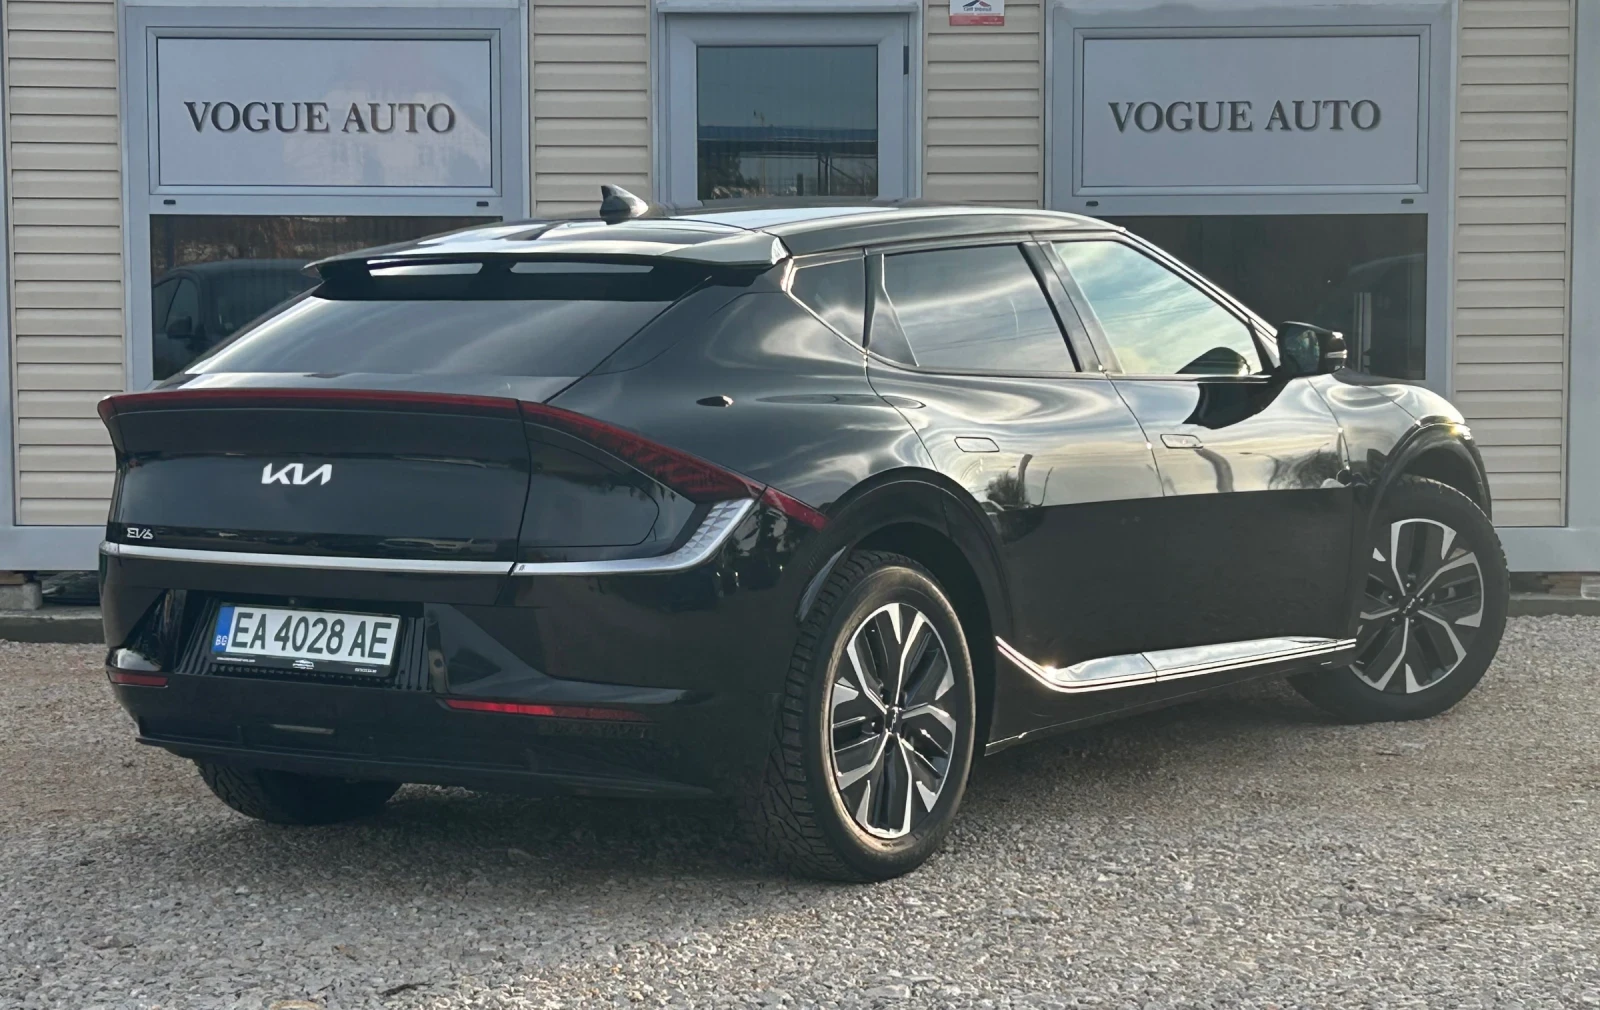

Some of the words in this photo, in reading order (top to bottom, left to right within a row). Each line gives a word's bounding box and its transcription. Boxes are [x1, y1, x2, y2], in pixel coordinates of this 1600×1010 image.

[184, 101, 330, 133] VOGUE
[341, 102, 457, 133] AUTO
[1108, 101, 1253, 133] VOGUE
[1265, 99, 1382, 132] AUTO
[261, 462, 333, 486] KIA
[126, 527, 154, 540] EV6
[214, 634, 228, 646] BG
[231, 611, 267, 650] EA
[274, 614, 345, 655] 4028
[348, 620, 392, 659] AE
